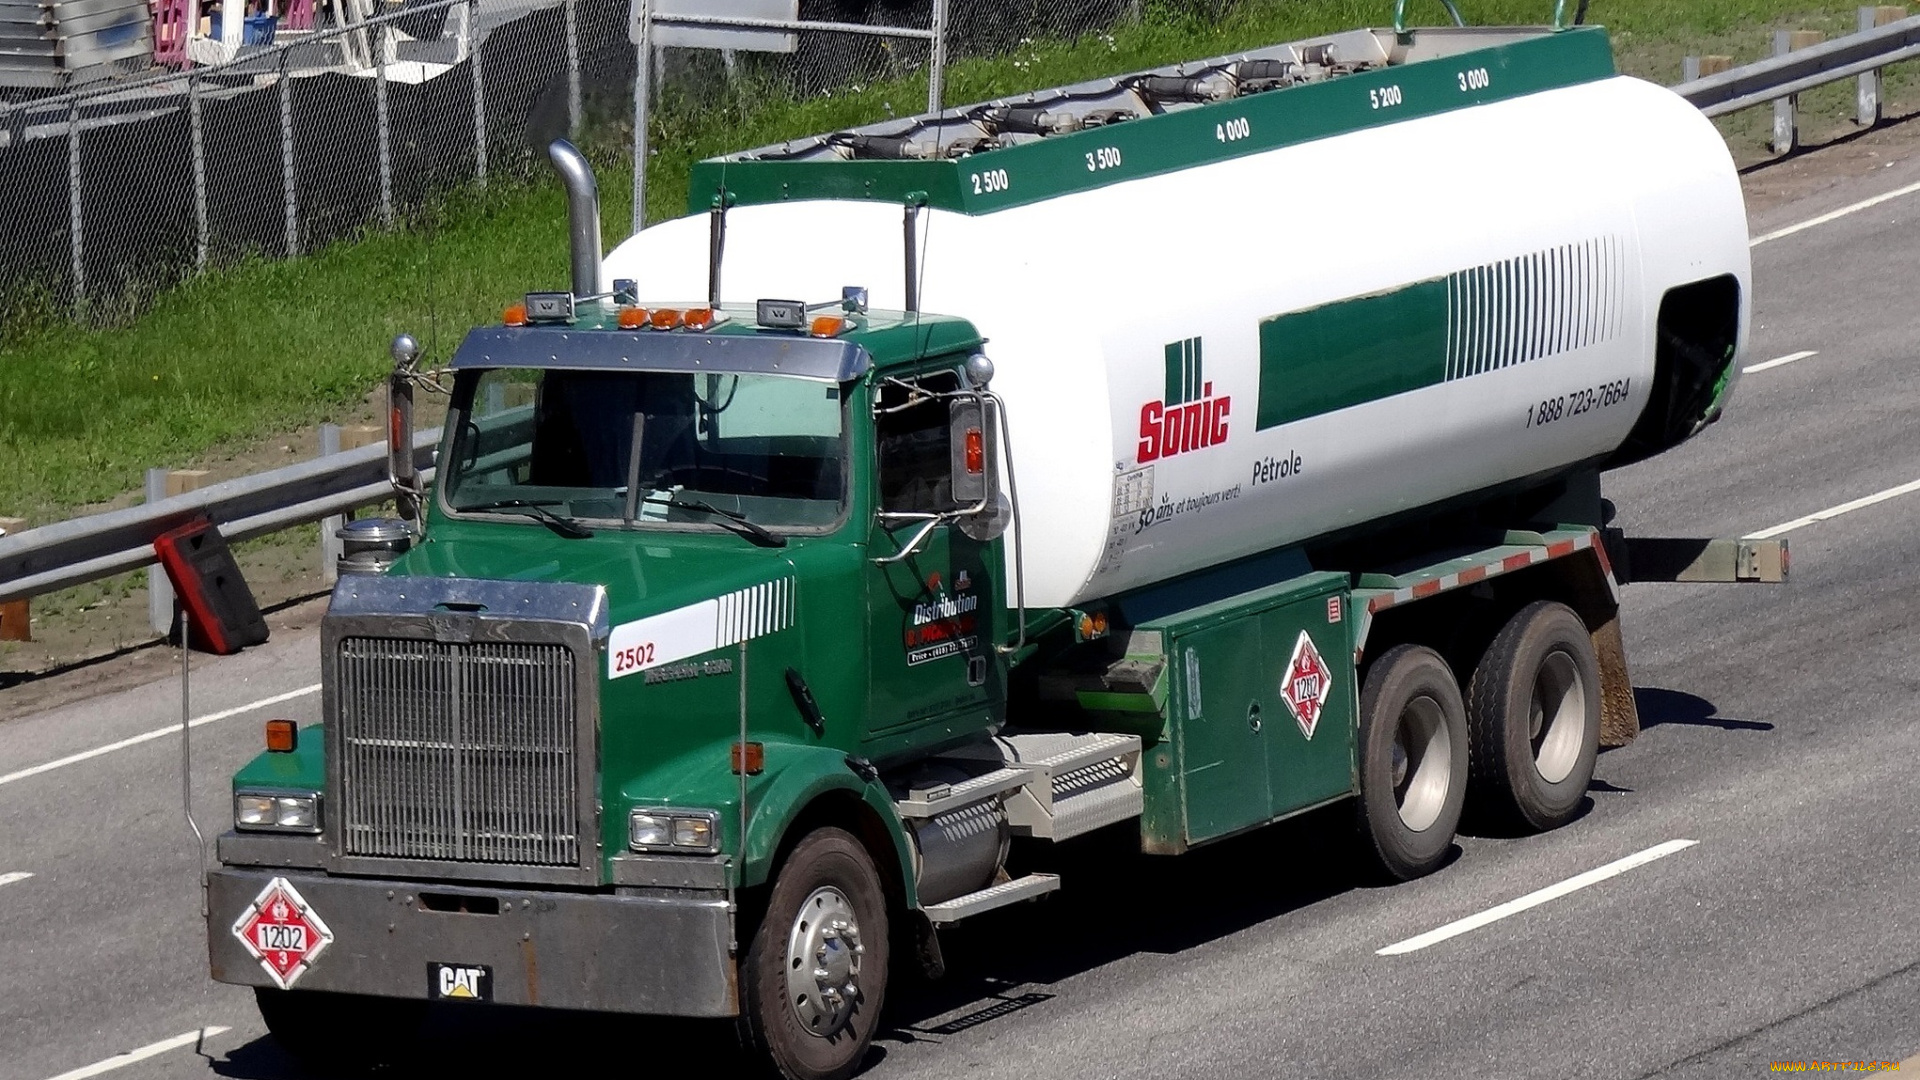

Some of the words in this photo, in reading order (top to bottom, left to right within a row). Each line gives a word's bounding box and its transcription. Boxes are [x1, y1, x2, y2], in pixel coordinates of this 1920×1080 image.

[1457, 71, 1467, 92] 3
[1468, 67, 1490, 90] 000
[1370, 89, 1379, 110] 5
[1380, 84, 1402, 107] 200
[1216, 123, 1225, 143] 4
[1226, 117, 1250, 141] 000
[1085, 152, 1096, 172] 3
[1097, 147, 1122, 170] 500
[971, 173, 982, 195] 2
[984, 168, 1009, 190] 500
[1526, 404, 1534, 429] 1
[1536, 396, 1564, 426] 888
[1566, 377, 1630, 418] 723-7664
[1137, 381, 1230, 464] Sonic
[1252, 449, 1302, 486] Pétrole
[1135, 507, 1155, 535] 50
[1156, 503, 1174, 521] ans
[1176, 501, 1186, 514] et
[1186, 491, 1220, 513] toujours
[1220, 483, 1242, 501] vert!
[914, 592, 978, 626] Distribution
[615, 642, 655, 672] 2502
[1296, 675, 1318, 701] 1202
[1306, 701, 1312, 714] 3
[261, 925, 303, 950] 1202
[279, 951, 288, 966] 3
[440, 966, 480, 998] CAT
